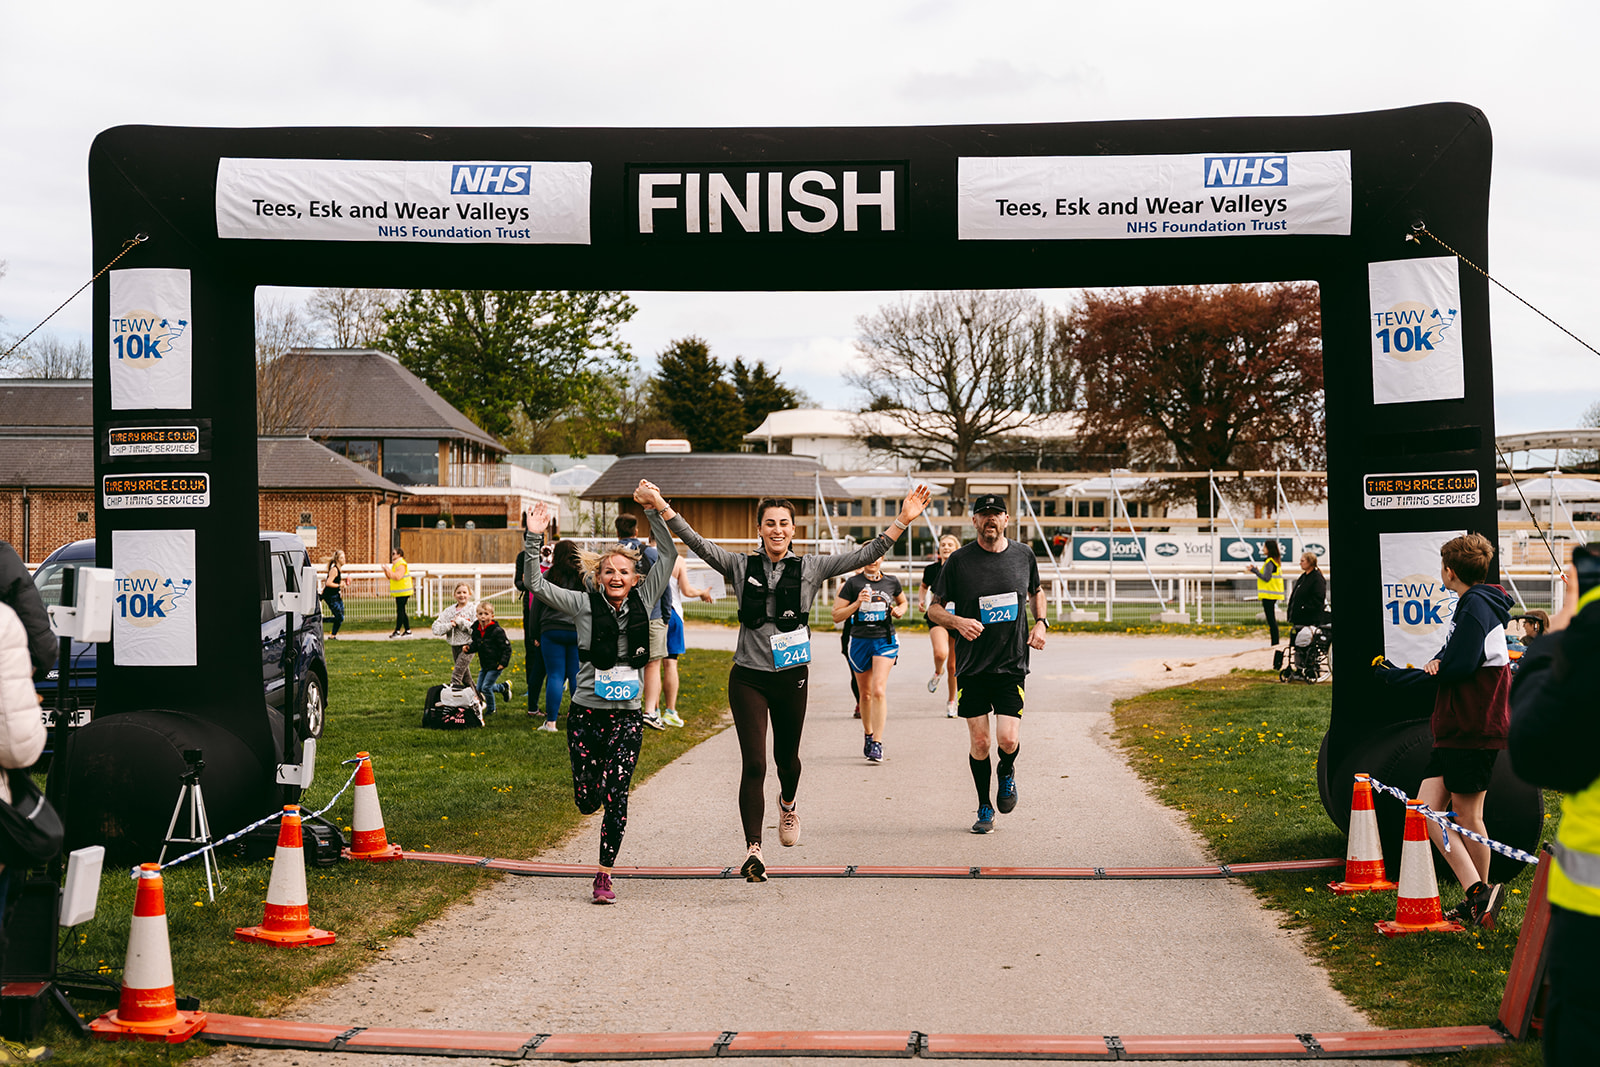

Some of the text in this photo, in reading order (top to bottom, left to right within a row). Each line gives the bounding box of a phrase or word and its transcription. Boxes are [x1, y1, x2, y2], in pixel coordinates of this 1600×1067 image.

[453, 166, 530, 193] NHS
[1206, 157, 1285, 186] NHS
[638, 170, 896, 233] FINISH
[996, 196, 1288, 218] Tees, Esk and Wear Valleys
[252, 200, 530, 225] Tees, Esk and Wear Valleys
[378, 226, 531, 239] NHS Foundation Trust
[1126, 219, 1288, 233] NHS Foundation Trust
[112, 318, 154, 332] TEWV
[1373, 309, 1425, 327] TEWV
[113, 334, 163, 359] 10k
[1375, 325, 1434, 353] 10k
[129, 445, 153, 454] TIMING
[155, 444, 195, 453] SERVICES
[107, 495, 205, 507] CHIP TIMING SERVICES
[1370, 493, 1476, 508] CHIP TIMING SERVICES
[115, 578, 158, 592] TEWV
[1384, 583, 1435, 598] TEWV
[115, 593, 167, 618] 10k
[1385, 599, 1444, 625] 10k
[863, 613, 880, 622] 281
[989, 609, 1012, 622] 224
[783, 647, 809, 665] 244
[605, 685, 631, 699] 296
